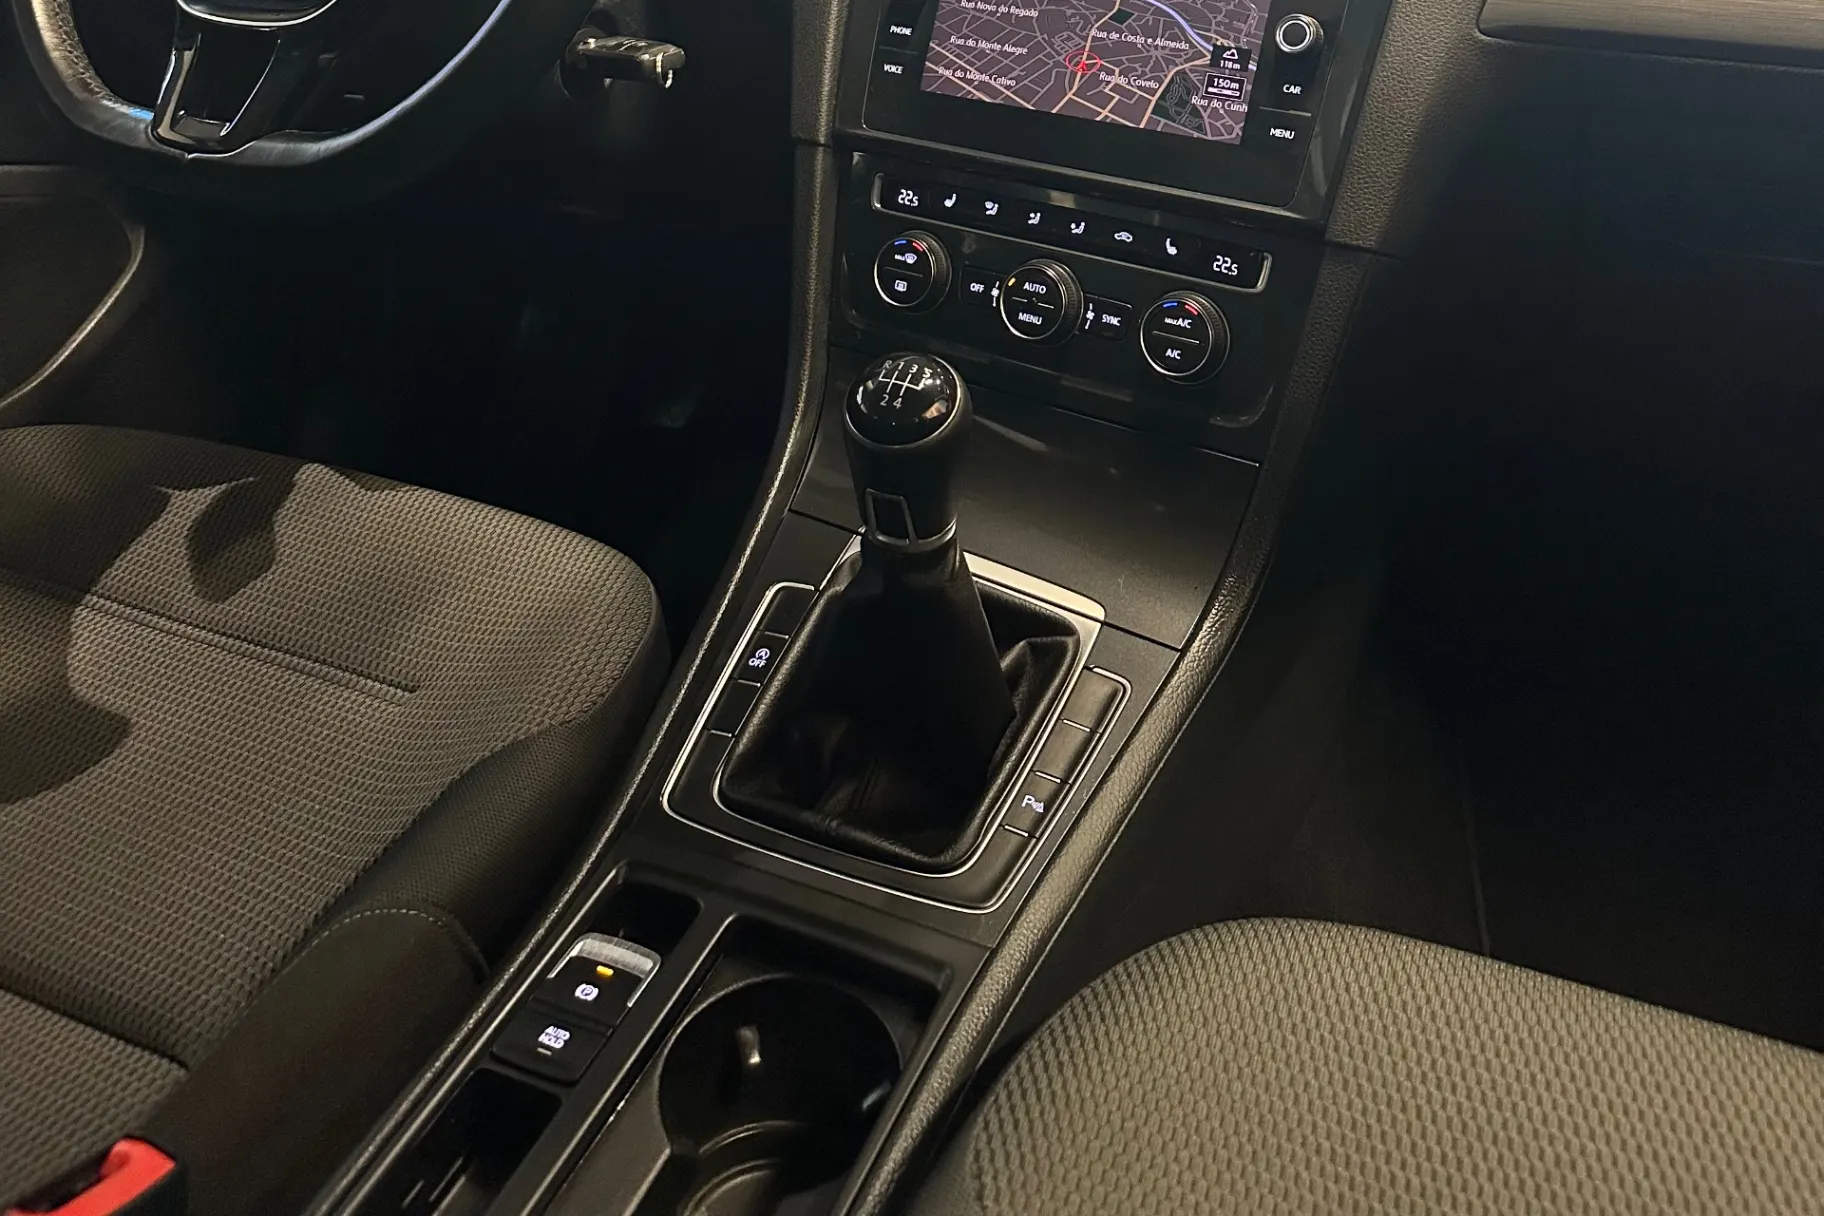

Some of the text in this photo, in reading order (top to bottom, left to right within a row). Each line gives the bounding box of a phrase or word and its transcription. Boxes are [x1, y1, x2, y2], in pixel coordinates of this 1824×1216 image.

[960, 0, 1039, 18] Rua Nova do Regado
[890, 25, 913, 36] PHONE
[950, 35, 1028, 55] Rua do Monte Alegre
[1092, 28, 1107, 39] Rua
[1109, 30, 1120, 40] de
[1122, 32, 1145, 44] Costa
[1154, 36, 1190, 50] Almeida
[883, 63, 903, 74] VOICE
[938, 66, 1016, 87] Rua do Monte Cativo
[1099, 72, 1159, 89] Rua do Covelo
[1283, 84, 1301, 95] CAR
[1191, 95, 1248, 113] Rua do Cunh
[1270, 127, 1295, 140] MENU
[970, 282, 985, 293] OFF
[1023, 281, 1047, 294] AUTO
[1018, 312, 1042, 325] MENU
[1101, 314, 1121, 326] SYNC
[1176, 317, 1193, 329] A/C
[1165, 348, 1182, 360] A/C
[883, 360, 892, 369] R
[909, 364, 918, 373] 3
[880, 394, 903, 409] 2 4
[748, 657, 767, 668] OFF
[1021, 794, 1036, 807] P
[543, 1025, 571, 1041] AUTO
[538, 1032, 565, 1049] HOLD
